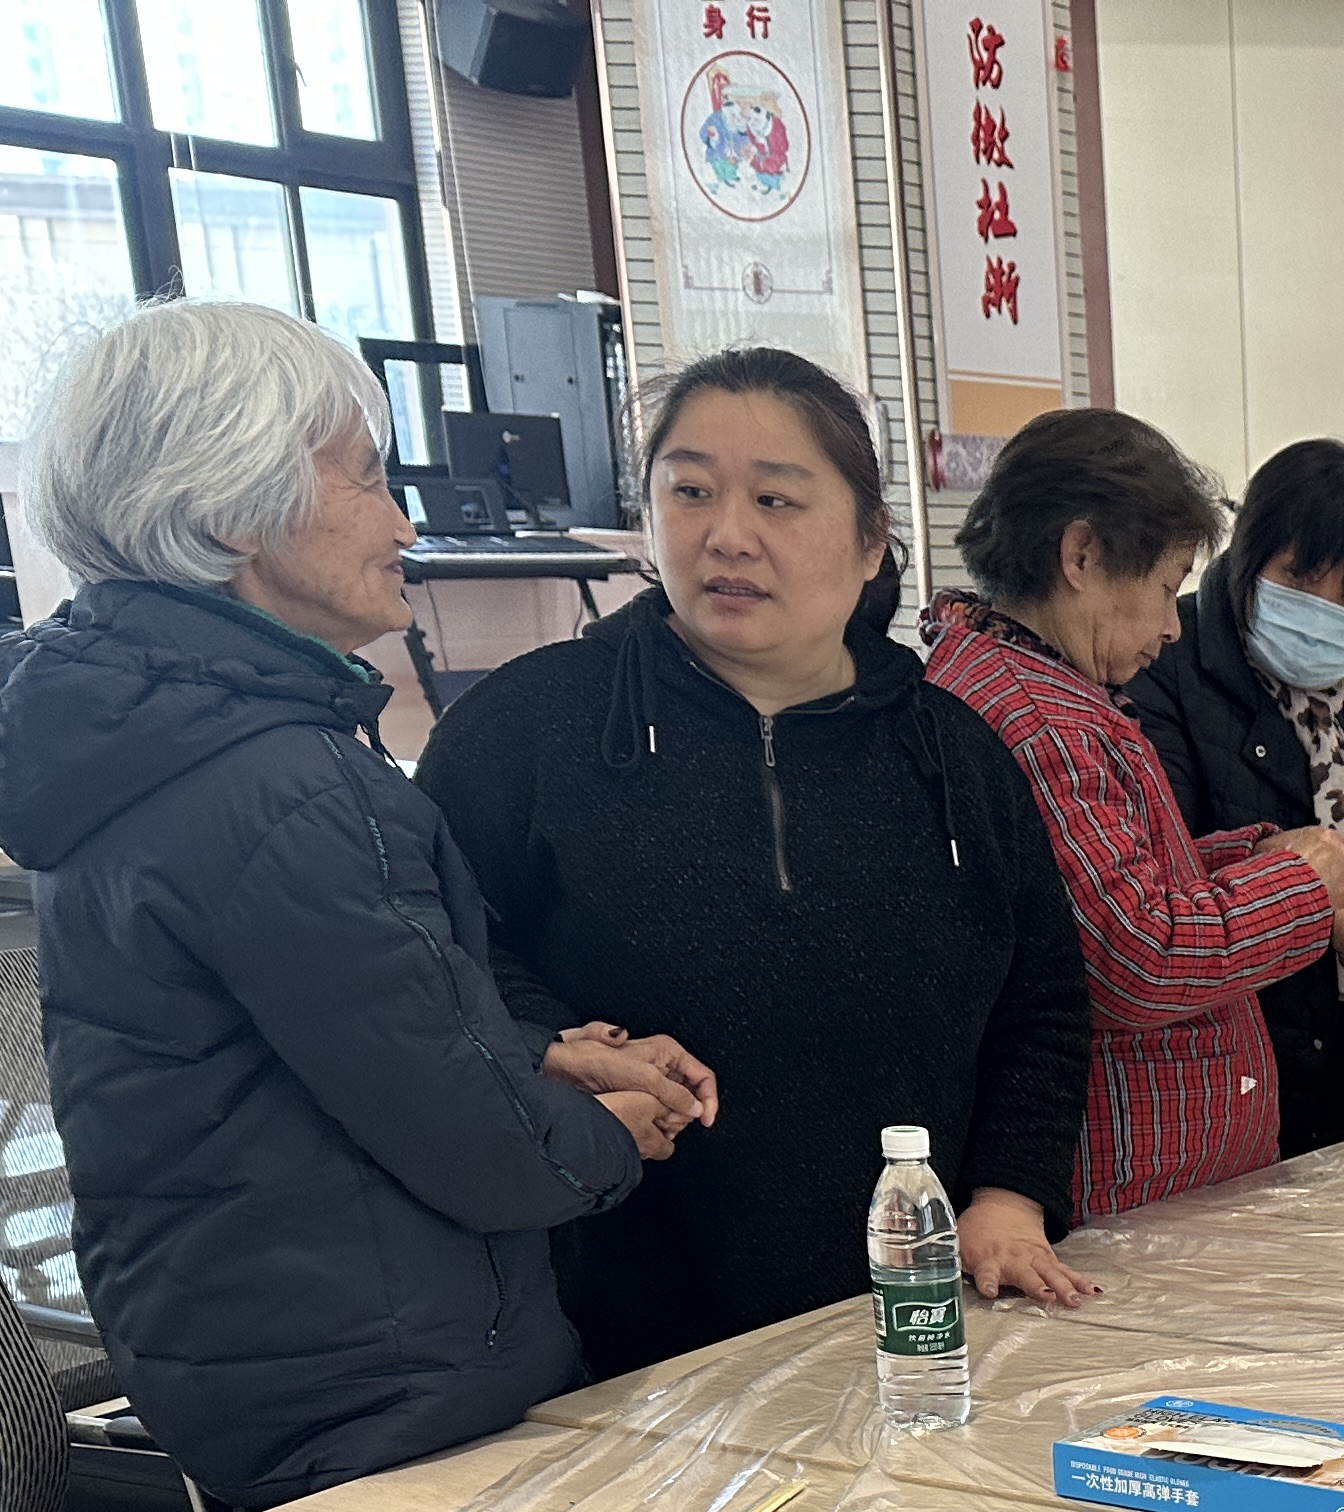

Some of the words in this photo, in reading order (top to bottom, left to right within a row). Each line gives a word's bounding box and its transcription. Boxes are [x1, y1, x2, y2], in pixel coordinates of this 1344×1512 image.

[1071, 1472, 1200, 1507] 一次性加厚高弹手套
